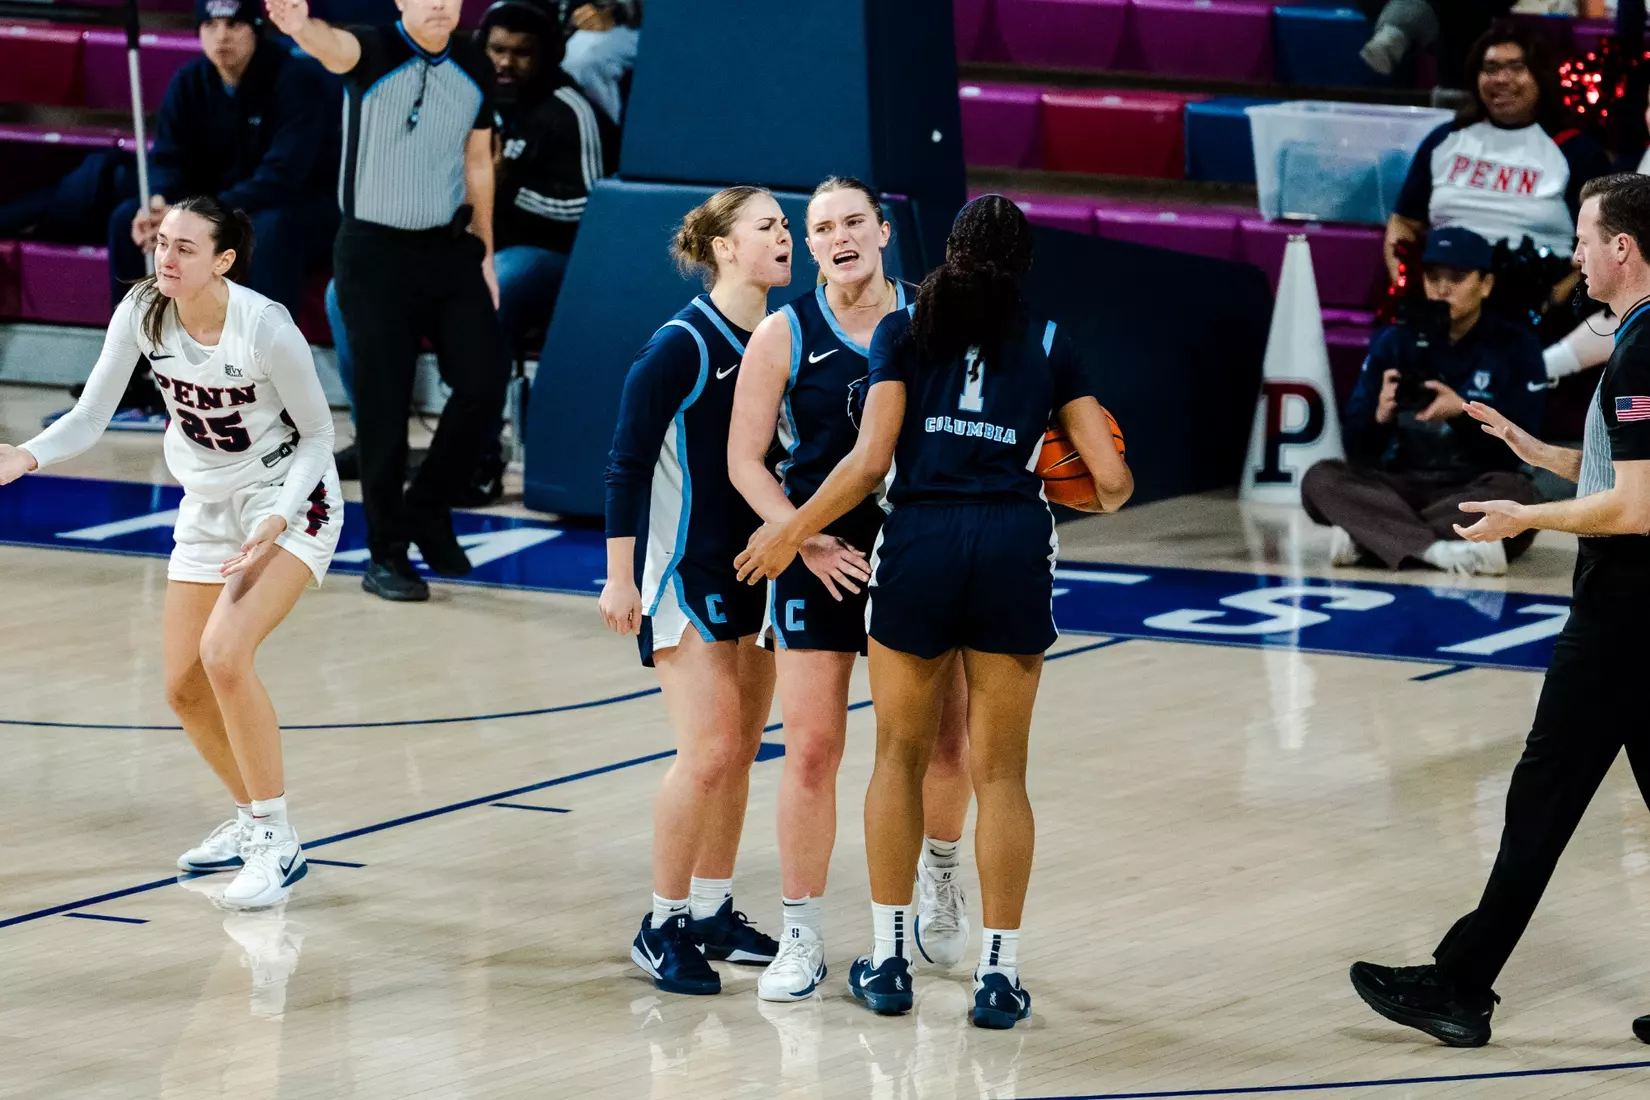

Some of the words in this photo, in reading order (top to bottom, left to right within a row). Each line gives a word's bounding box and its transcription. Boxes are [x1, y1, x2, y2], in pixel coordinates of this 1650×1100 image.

[1448, 154, 1540, 196] PENN
[154, 371, 257, 410] PENN
[959, 344, 985, 412] 1
[176, 407, 252, 453] 25
[925, 416, 1017, 445] COLUMBIA
[1253, 381, 1325, 484] P
[705, 593, 728, 624] C
[785, 599, 805, 631] C
